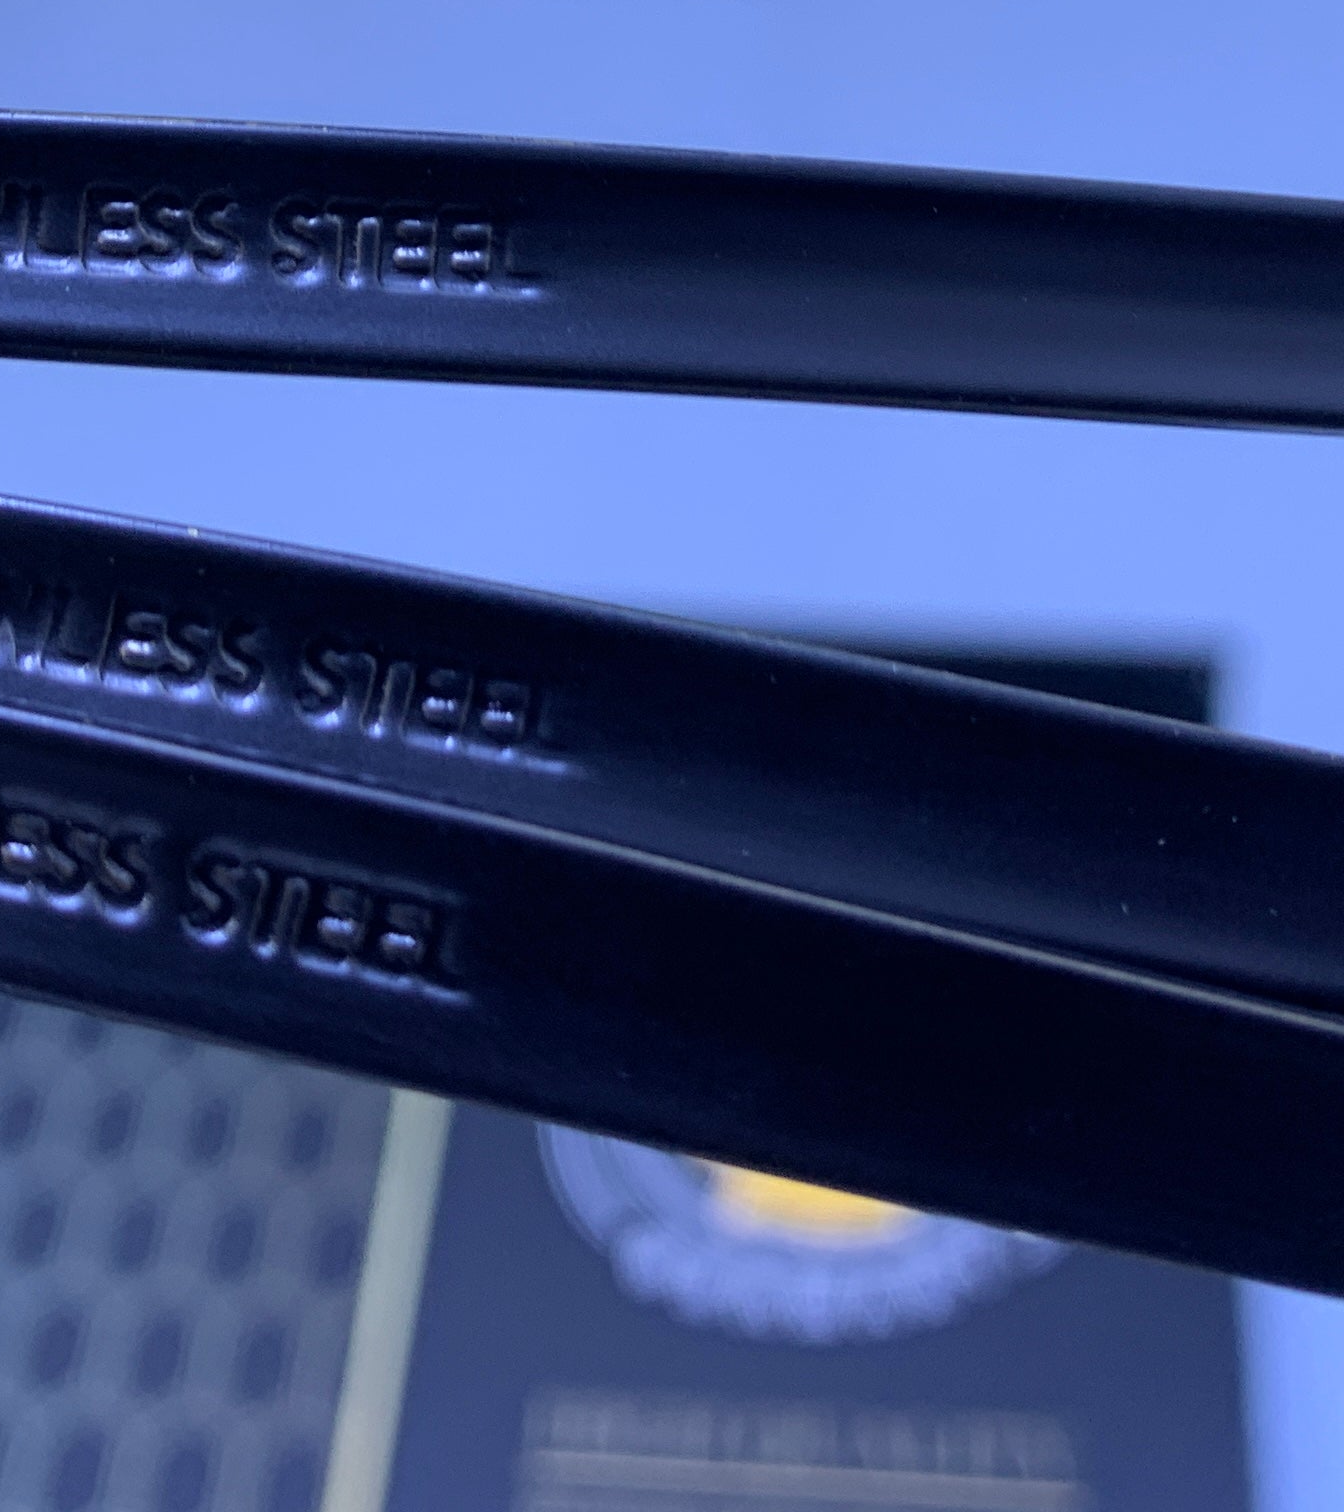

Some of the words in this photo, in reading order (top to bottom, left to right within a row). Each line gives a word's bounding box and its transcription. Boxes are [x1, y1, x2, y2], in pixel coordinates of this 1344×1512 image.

[270, 192, 546, 299] STEEL
[295, 636, 575, 775] STEEL
[180, 842, 471, 1005] STEEL
